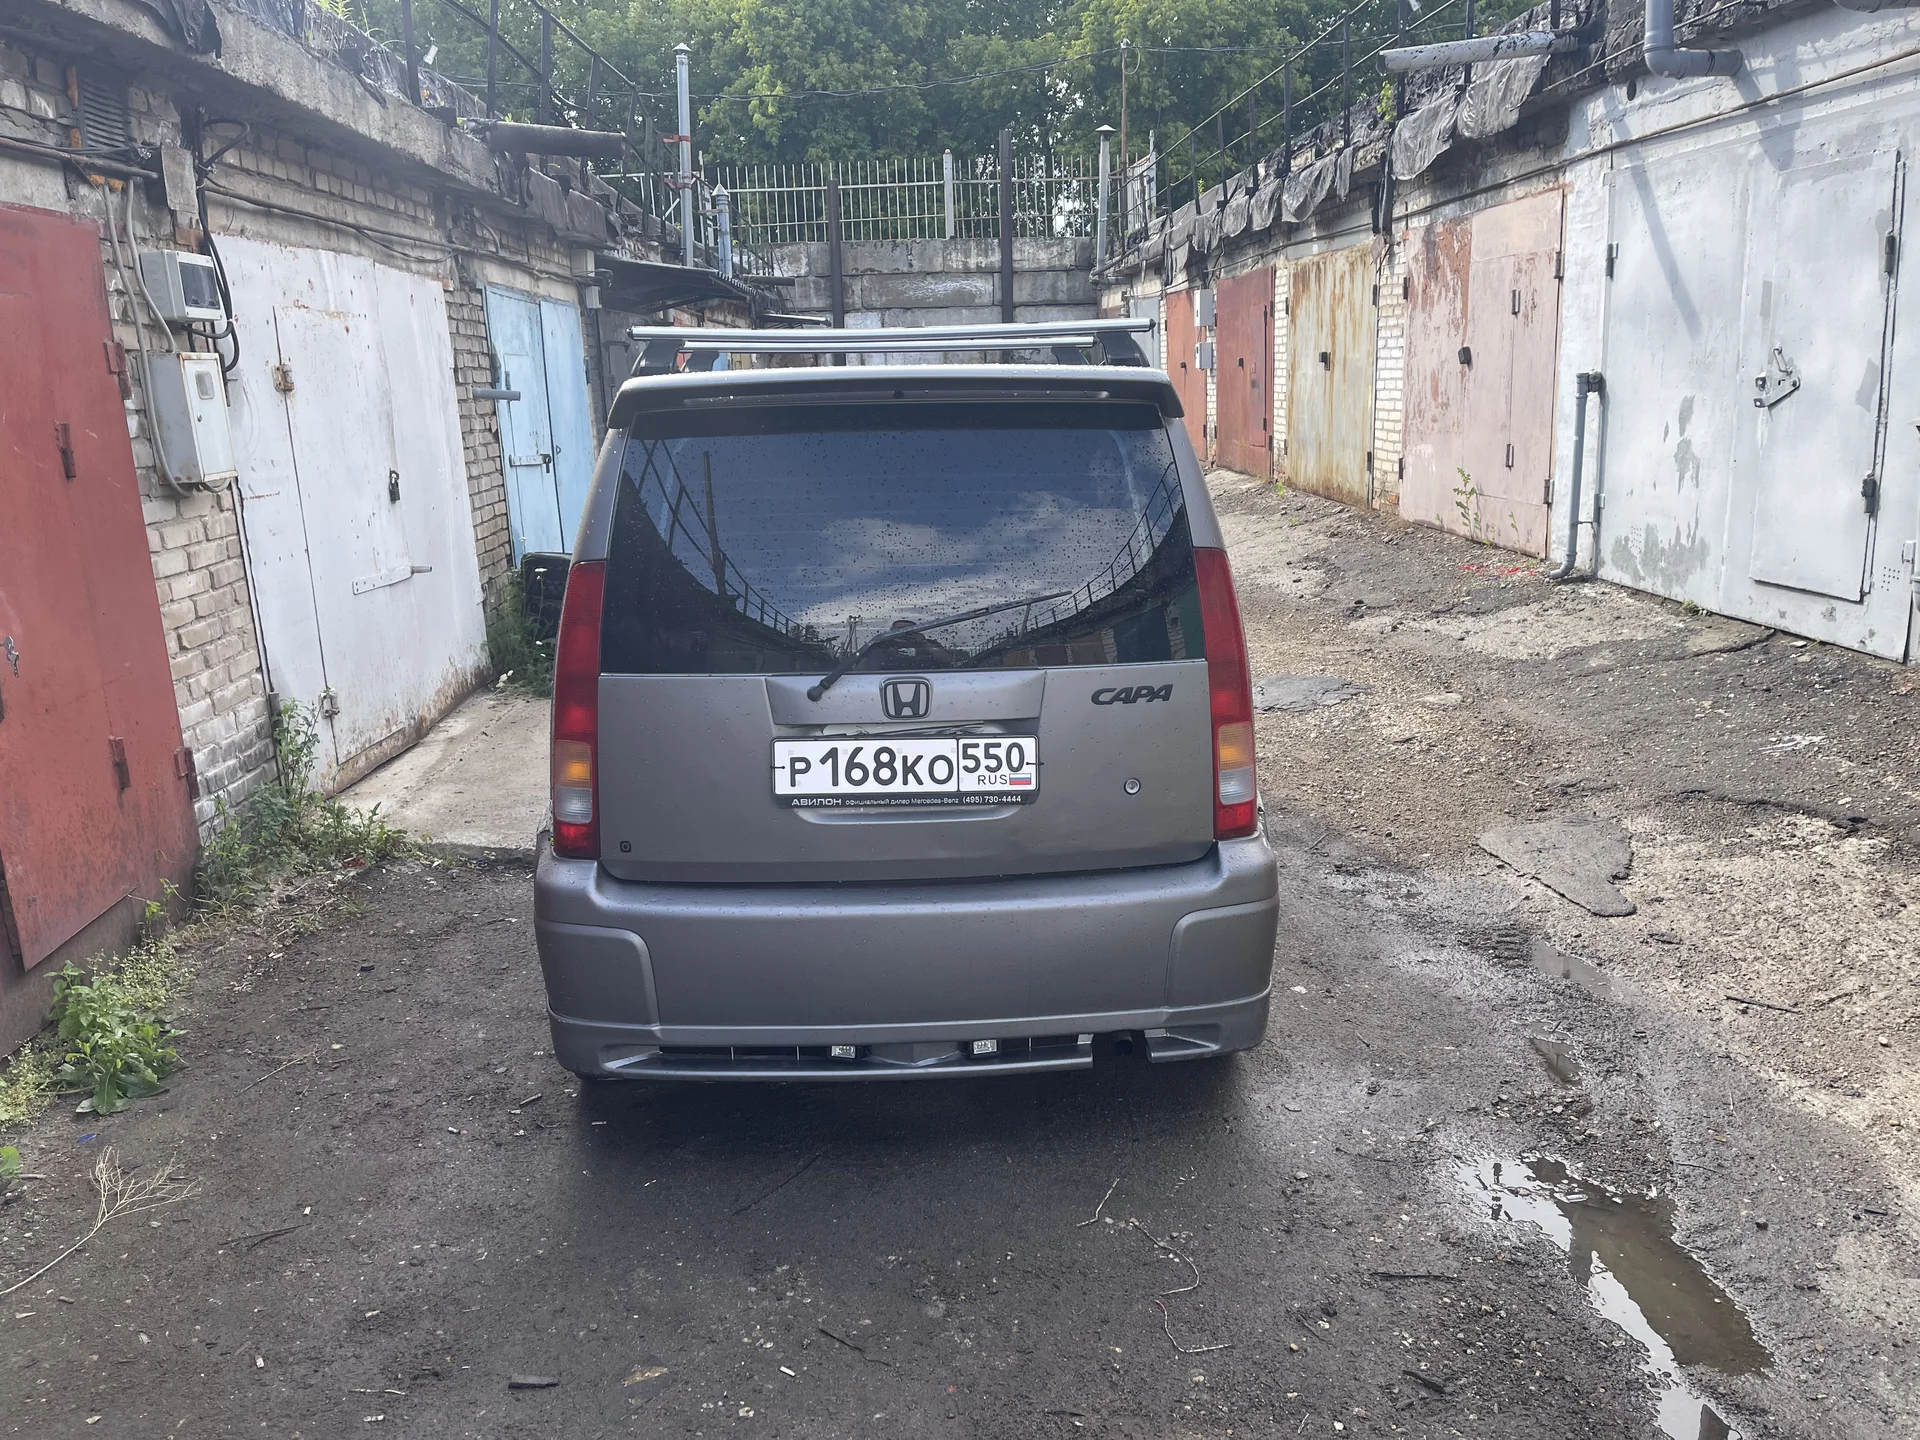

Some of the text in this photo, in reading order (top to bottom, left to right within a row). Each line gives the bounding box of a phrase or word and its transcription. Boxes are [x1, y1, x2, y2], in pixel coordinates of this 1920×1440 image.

[1091, 684, 1173, 705] CAPA
[962, 742, 1025, 773] 550
[977, 773, 1008, 785] RUS
[791, 798, 842, 806] АВИЛОН
[962, 795, 982, 804] (495)
[984, 795, 1021, 803] 730-4444
